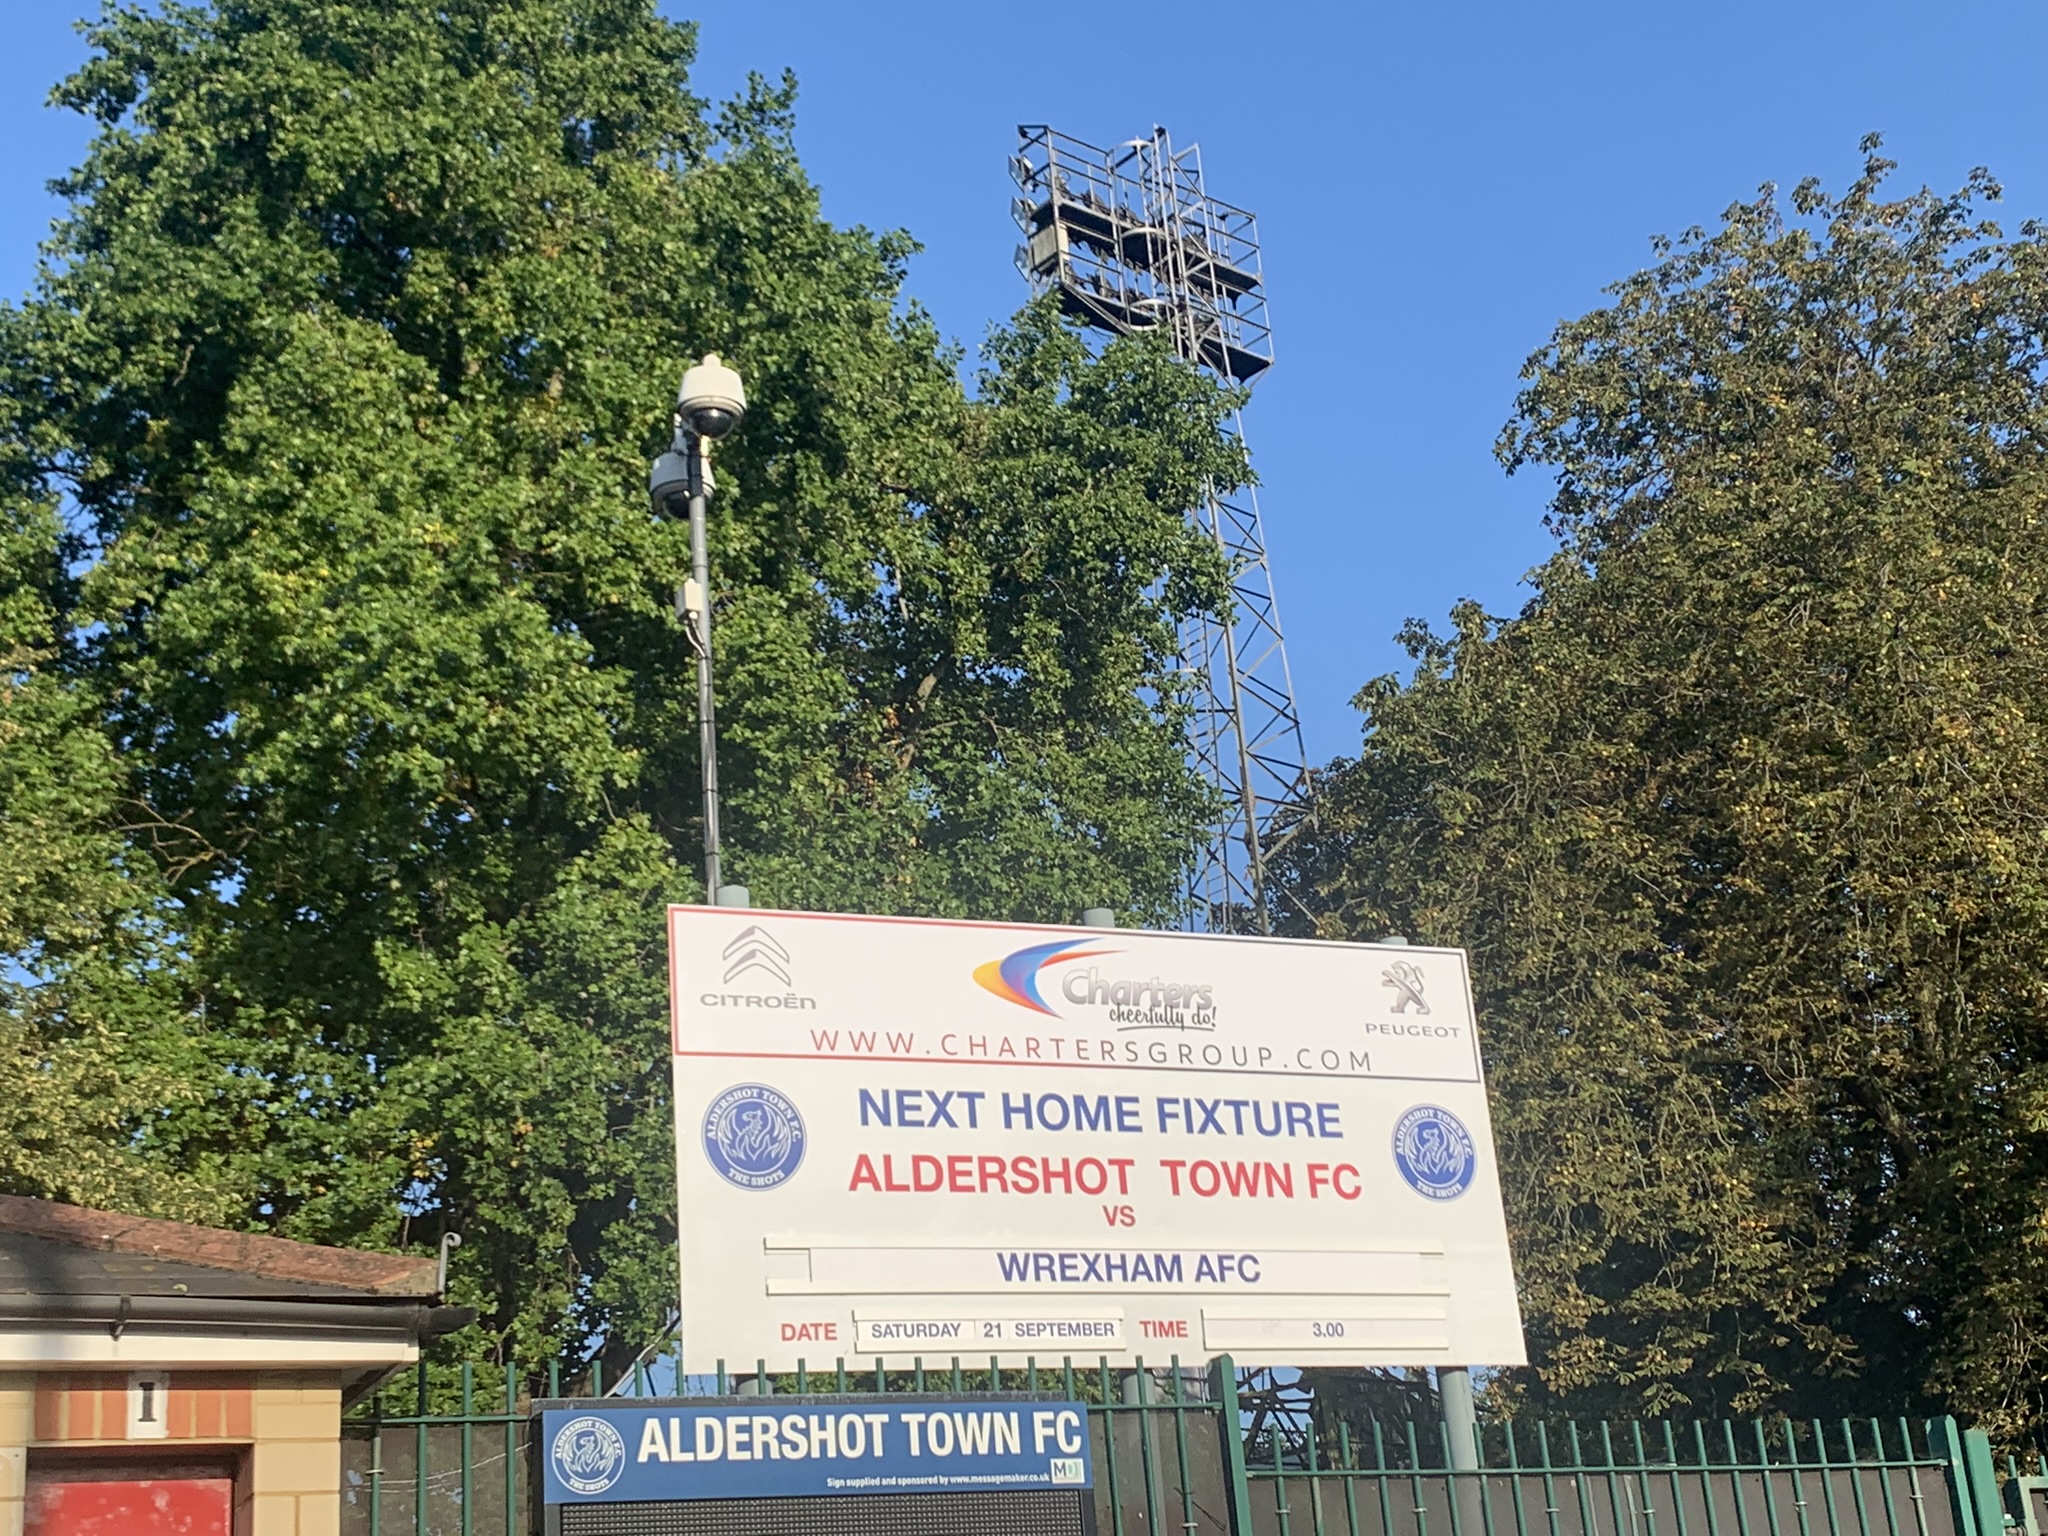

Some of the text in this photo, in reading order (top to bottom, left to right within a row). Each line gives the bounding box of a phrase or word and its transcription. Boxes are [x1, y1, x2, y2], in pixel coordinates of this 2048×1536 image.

[1062, 966, 1213, 1010] Charters
[1109, 1002, 1217, 1031] cheerfully do!
[1365, 1022, 1461, 1038] PEUGEOT
[810, 1029, 1371, 1072] WWW.CHARTERSGROUP.COM
[706, 1087, 802, 1143] ALDERSHOT TOWN F.C.
[858, 1088, 1344, 1139] NEXT HOME FIXTURE
[1395, 1108, 1436, 1156] ALDERSHOT
[1436, 1109, 1466, 1138] TOWN
[727, 1167, 786, 1186] THE SHOTS
[848, 1154, 1363, 1201] ALDERSHOT TOWN FC
[1415, 1180, 1435, 1197] THE
[1101, 1205, 1136, 1228] VS
[996, 1252, 1261, 1283] WREXHAM AFC
[780, 1322, 838, 1342] DATE
[871, 1321, 1115, 1339] SATURDAY 21 SEPTEMBER
[1139, 1319, 1190, 1339] TIME
[1312, 1321, 1345, 1338] 3.00
[555, 1420, 594, 1459] ALDERSHOT
[594, 1421, 618, 1442] TOWN
[637, 1409, 1083, 1463] ALDERSHOT TOWN FC
[569, 1478, 585, 1490] THE
[827, 1472, 1051, 1489] Sign supplied and sponsored by www.messagemaker.co.uk
